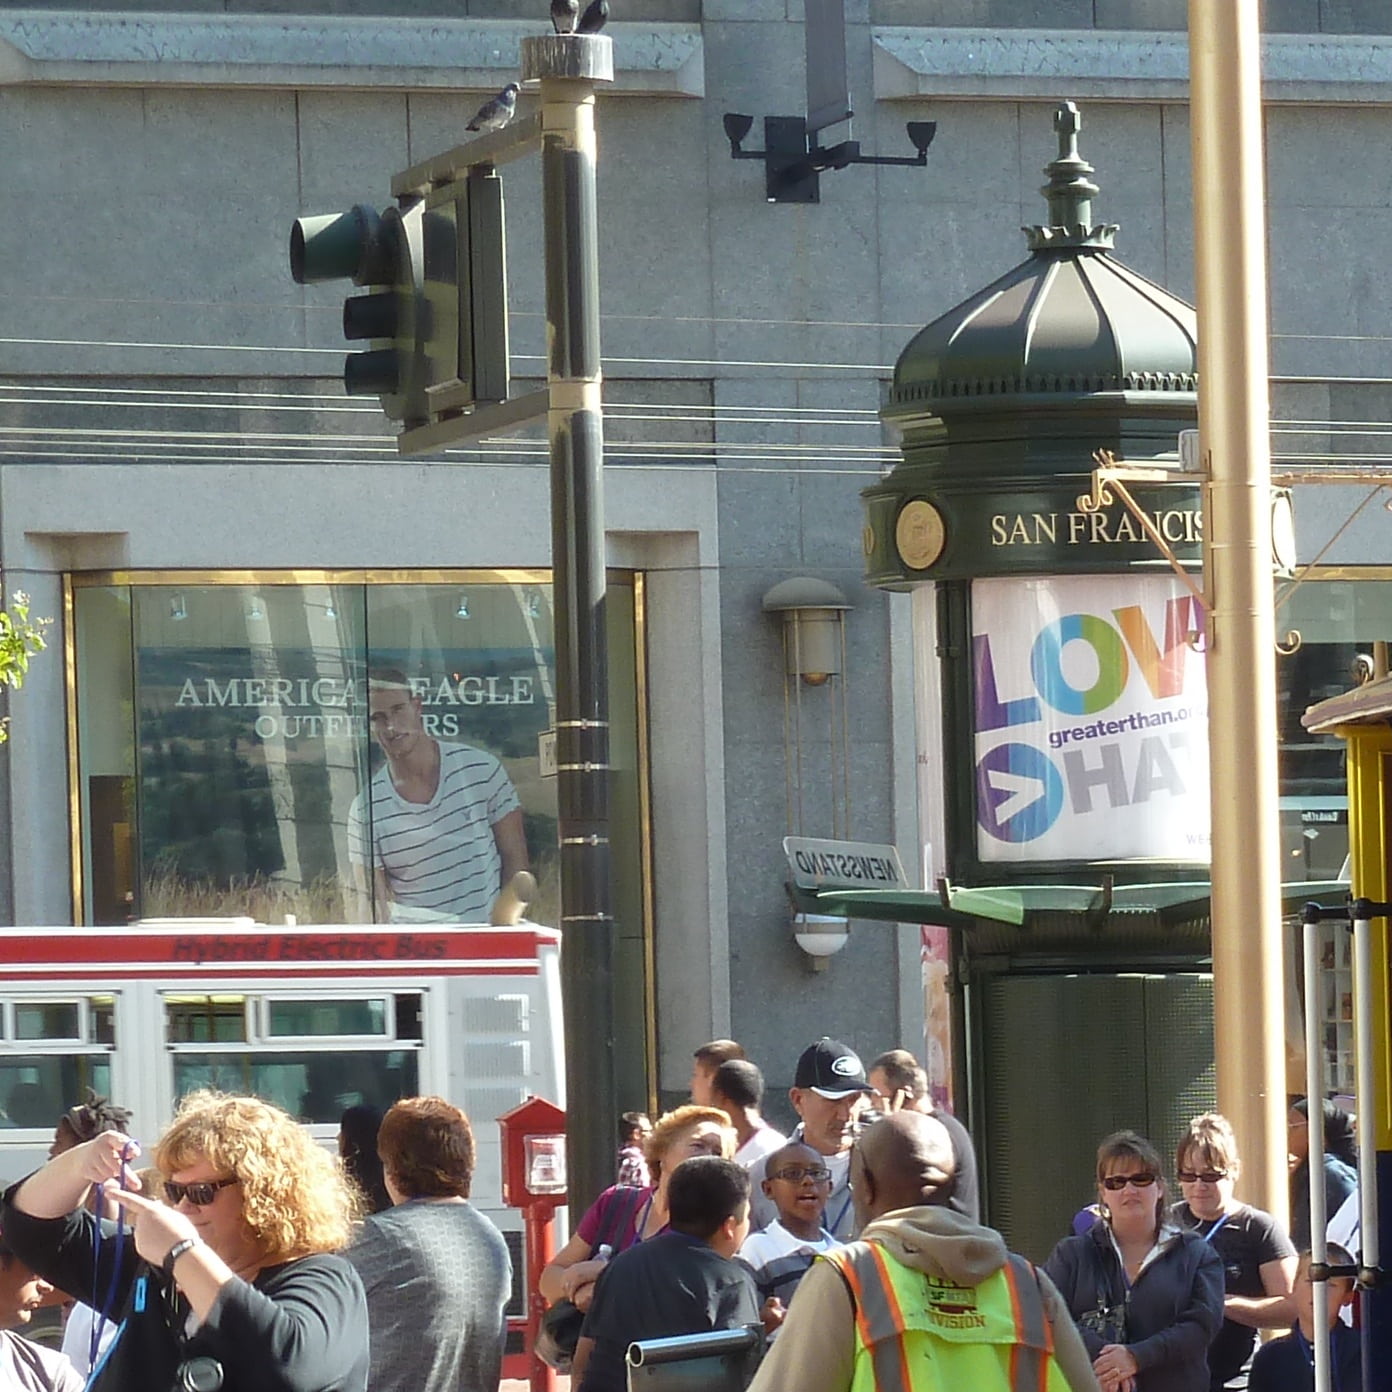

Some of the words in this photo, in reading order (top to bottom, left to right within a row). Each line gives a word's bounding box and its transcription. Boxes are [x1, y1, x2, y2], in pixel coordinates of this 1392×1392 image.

[992, 513, 1058, 546] SAN
[973, 596, 1208, 733] LOV
[175, 677, 360, 707] AMERICA
[411, 675, 534, 706] EAGLE
[174, 934, 270, 966] Hybrid
[279, 933, 388, 962] Electric
[396, 933, 448, 960] Bus
